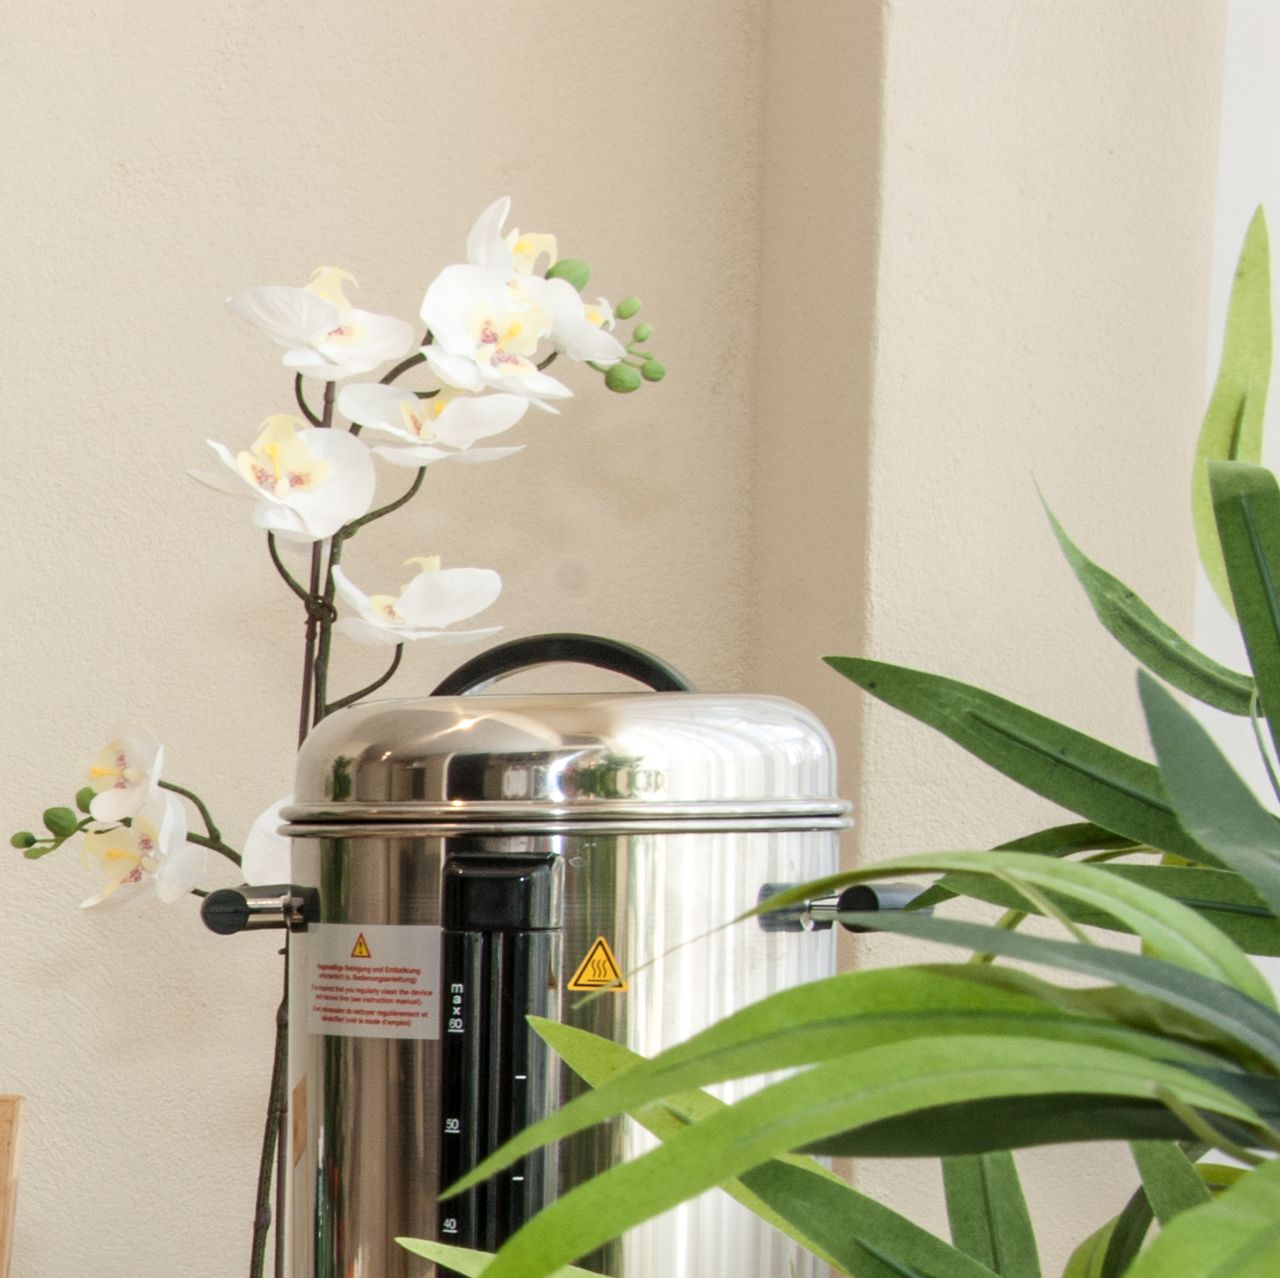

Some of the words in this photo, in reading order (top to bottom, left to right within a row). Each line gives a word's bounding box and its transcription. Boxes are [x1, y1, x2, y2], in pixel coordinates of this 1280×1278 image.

[448, 1018, 463, 1029] 60
[445, 1118, 459, 1130] 50
[443, 1218, 457, 1230] 40
